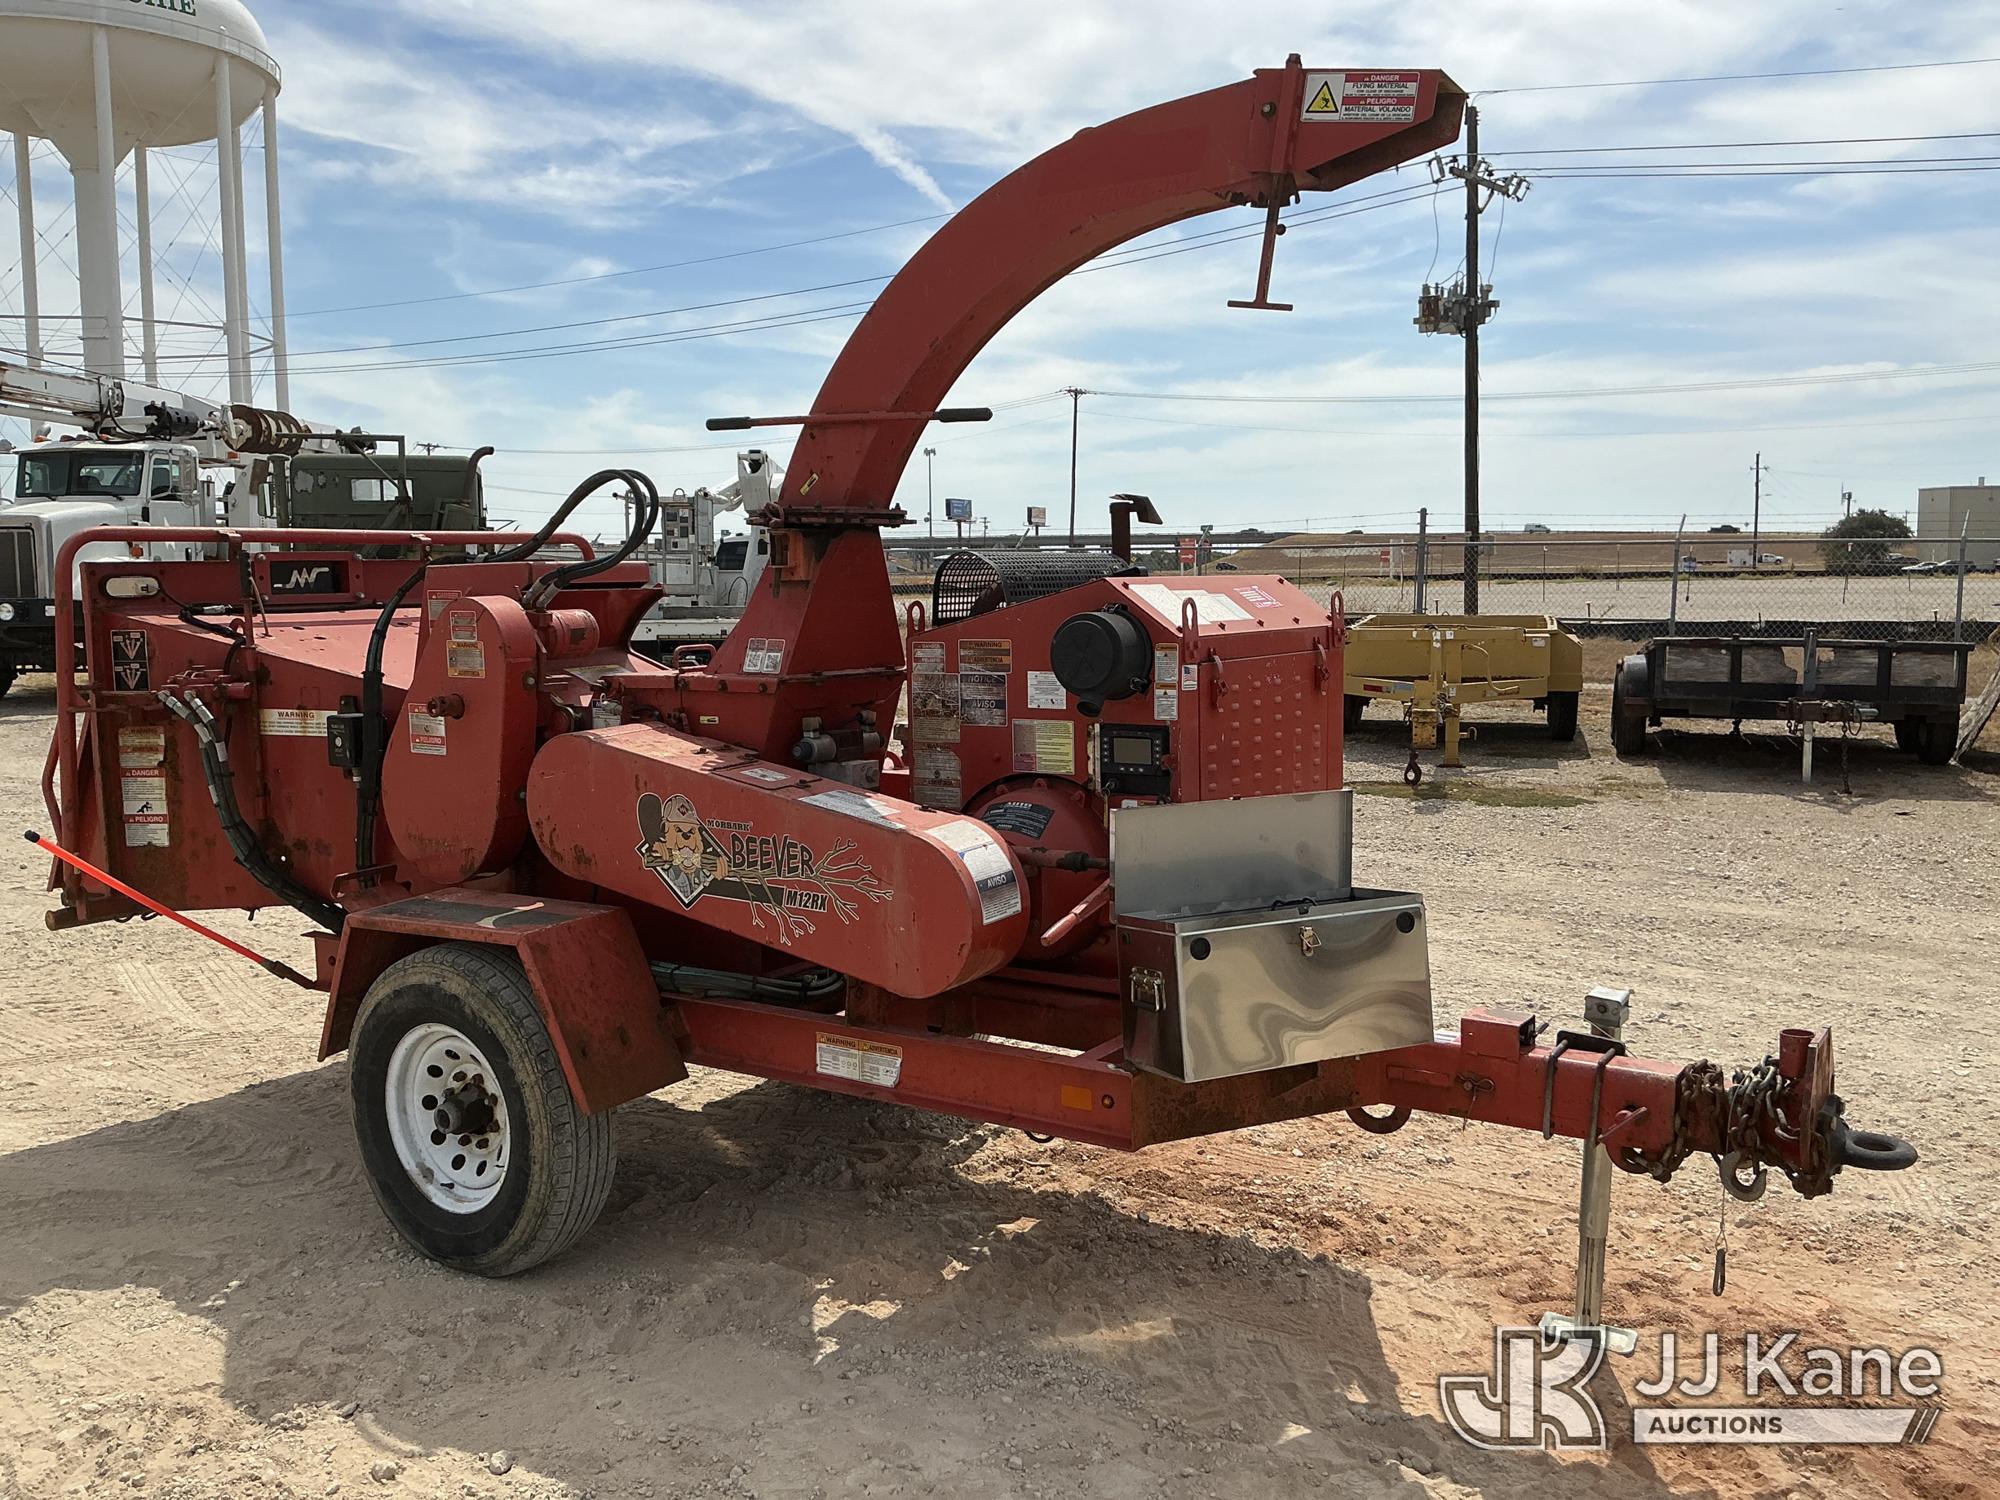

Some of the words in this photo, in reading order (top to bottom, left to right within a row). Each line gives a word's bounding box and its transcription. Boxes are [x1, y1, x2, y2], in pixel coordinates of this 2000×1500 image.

[277, 711, 315, 719] WARNING
[707, 819, 750, 831] MORBARK
[730, 832, 815, 878] BEEVER
[987, 874, 1007, 889] AVISO
[786, 889, 827, 911] M12RX
[825, 1035, 856, 1048] WARNING
